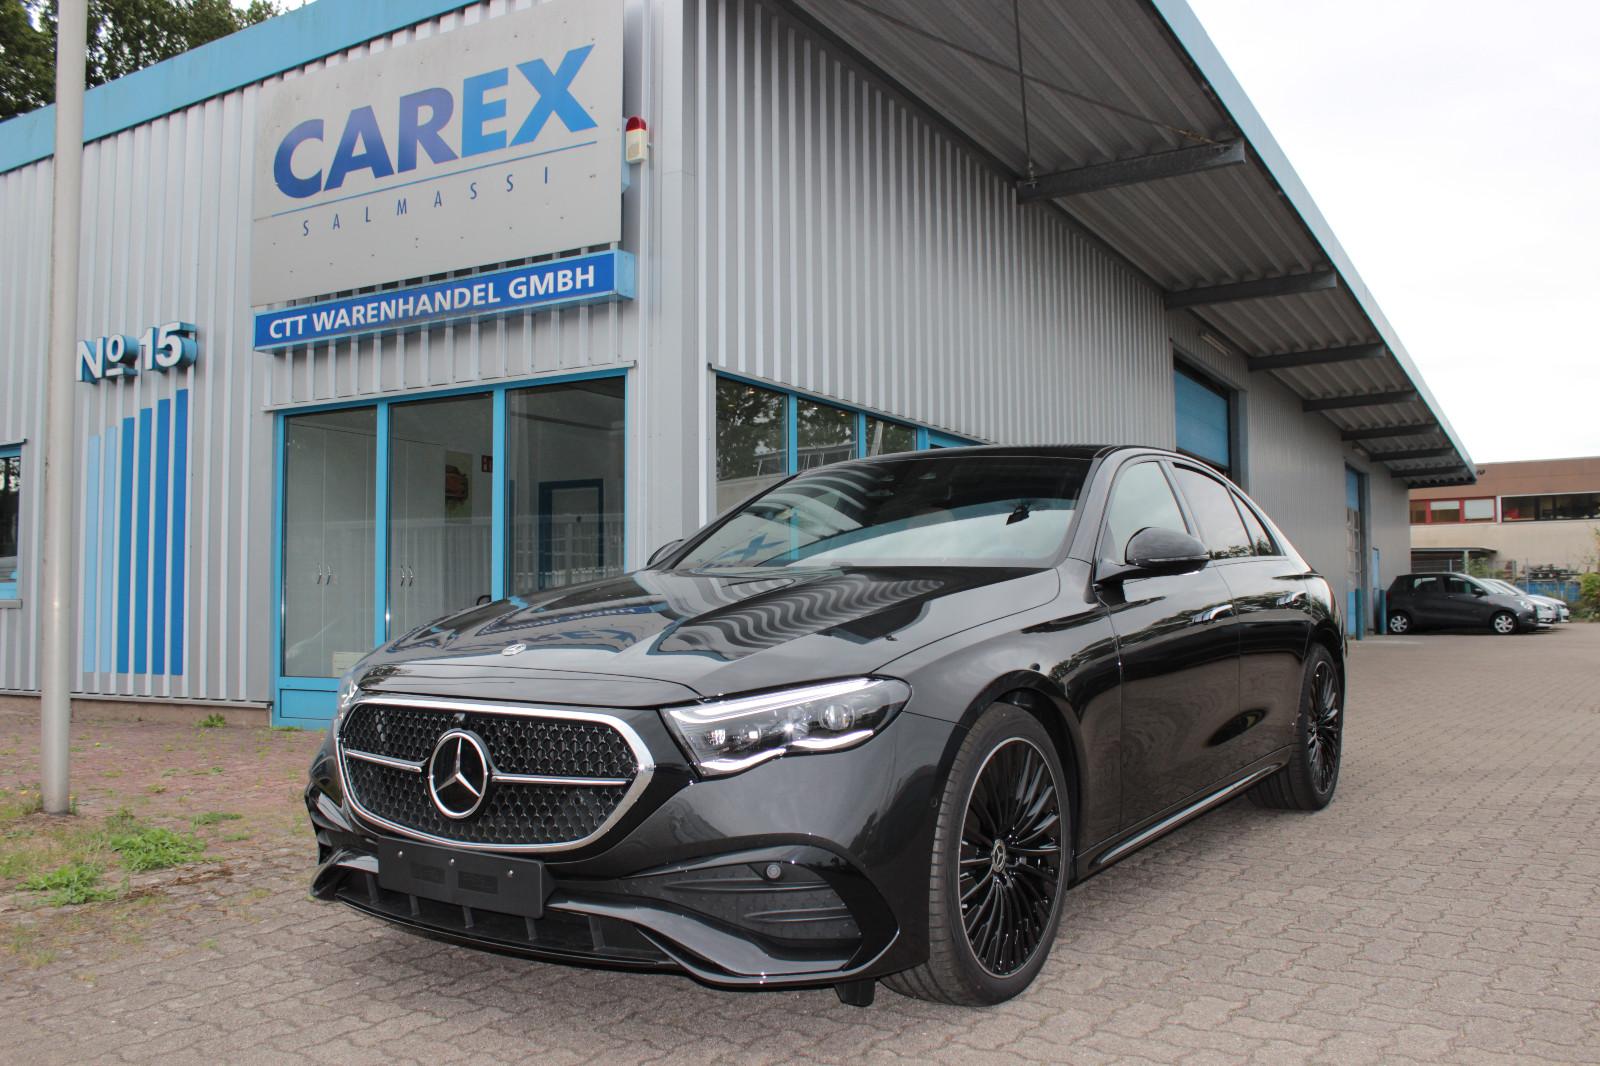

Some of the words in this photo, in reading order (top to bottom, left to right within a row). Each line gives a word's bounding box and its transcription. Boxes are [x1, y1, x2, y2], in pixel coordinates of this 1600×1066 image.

[274, 44, 598, 199] CAREX
[302, 166, 549, 236] SALMASSI
[269, 315, 307, 339] CTT
[312, 283, 500, 331] WARENHANDEL
[509, 265, 595, 300] GMBH
[140, 322, 187, 370] 15
